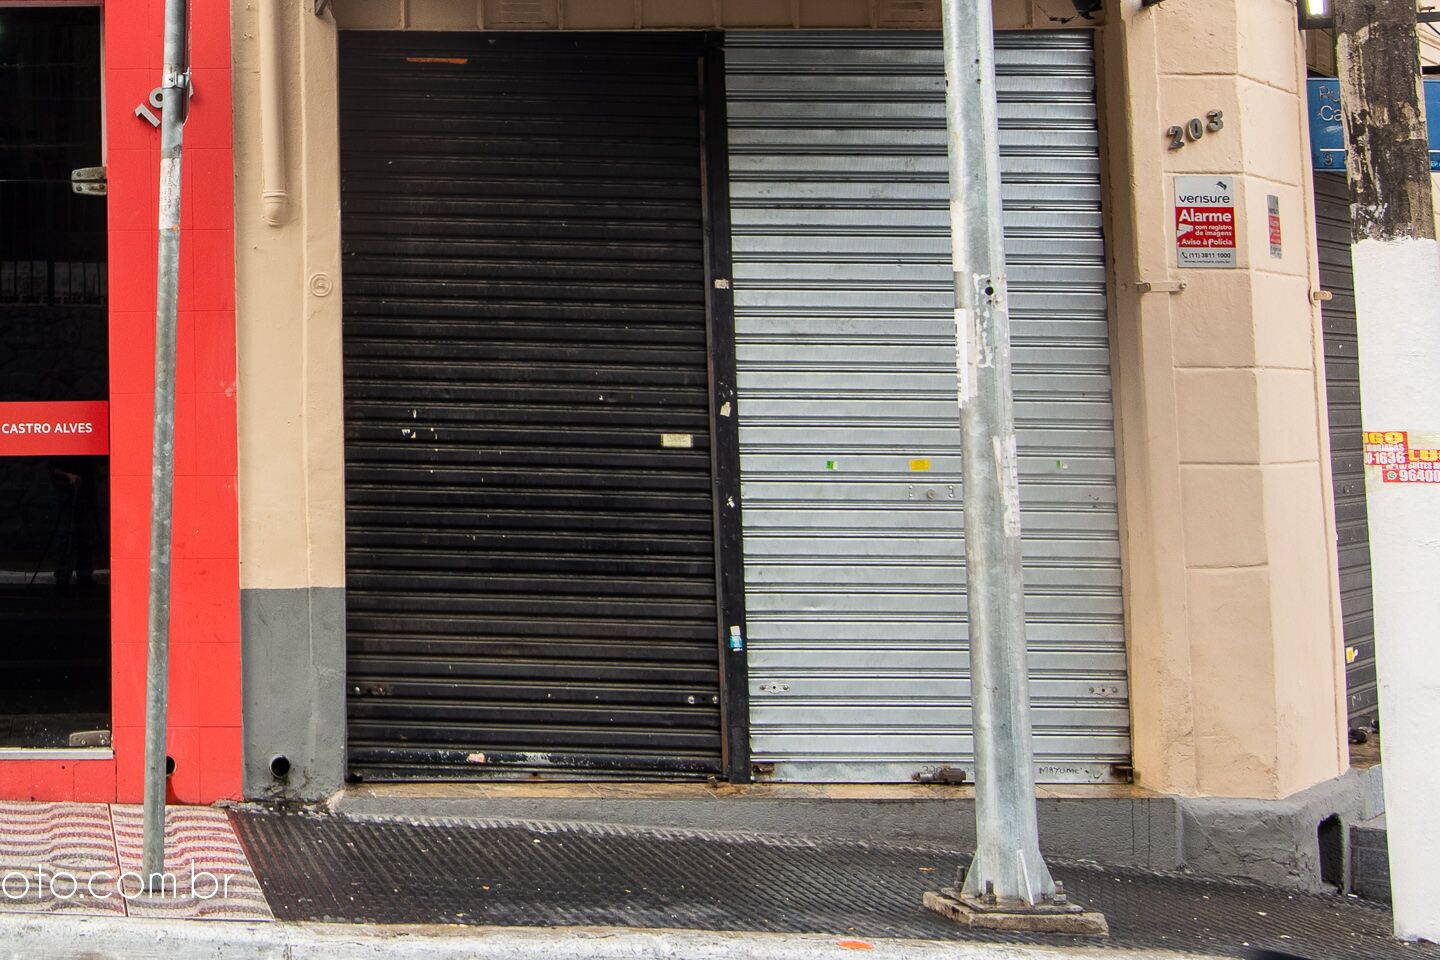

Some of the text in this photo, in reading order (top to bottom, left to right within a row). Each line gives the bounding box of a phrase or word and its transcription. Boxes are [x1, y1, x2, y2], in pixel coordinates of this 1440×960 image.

[1166, 109, 1224, 151] 203
[1179, 195, 1230, 204] verisure
[1179, 208, 1232, 222] Alarme
[1208, 224, 1232, 232] registro
[1, 423, 51, 434] CASTRO
[54, 422, 93, 433] ALVES
